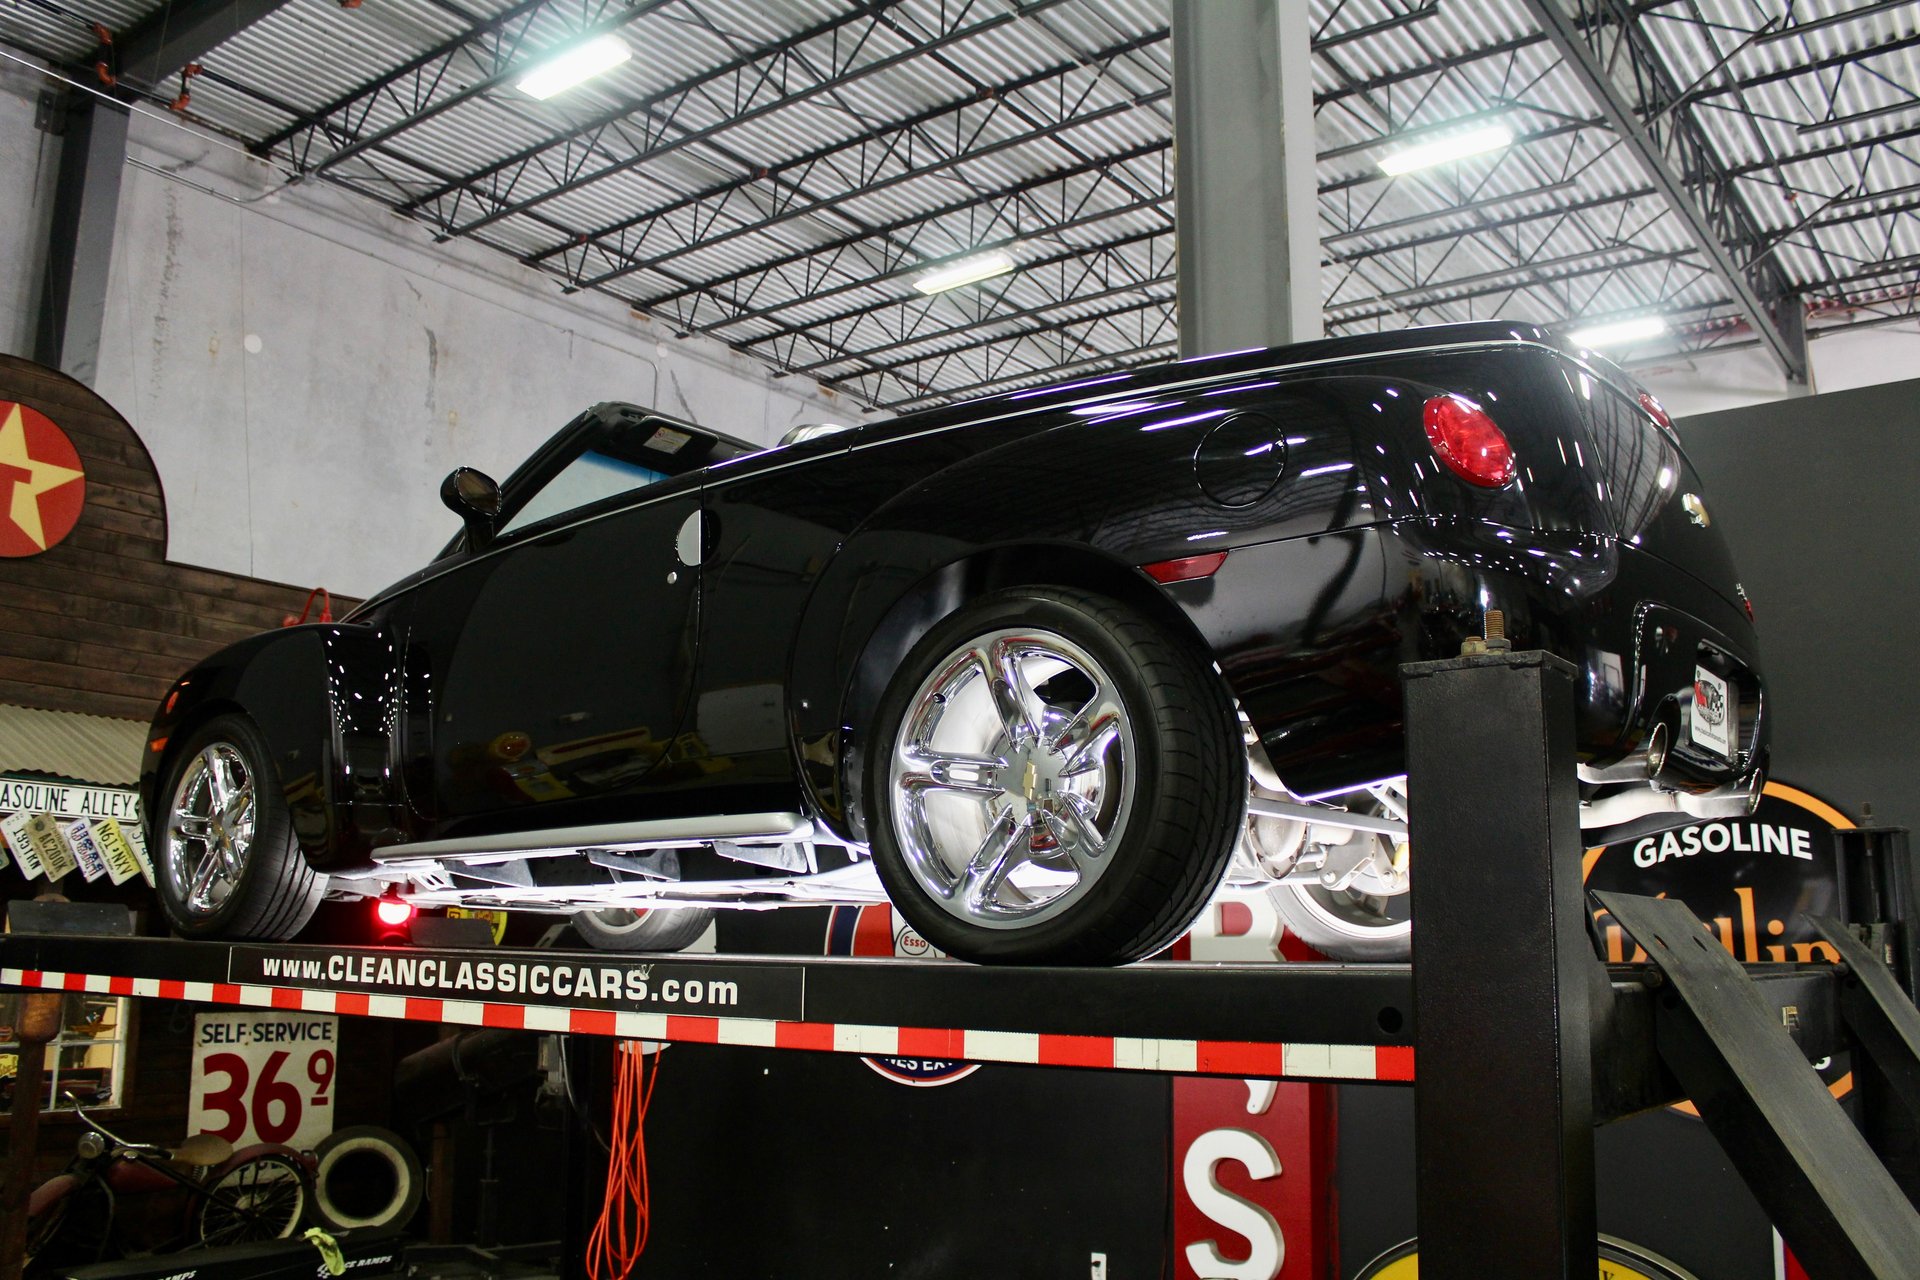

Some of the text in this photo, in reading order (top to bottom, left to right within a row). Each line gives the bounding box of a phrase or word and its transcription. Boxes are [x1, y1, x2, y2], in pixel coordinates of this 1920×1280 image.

[80, 791, 132, 817] ALLEY
[1633, 822, 1813, 869] GASOLINE
[263, 954, 738, 1005] www.CLEANCLASSICCARS.com
